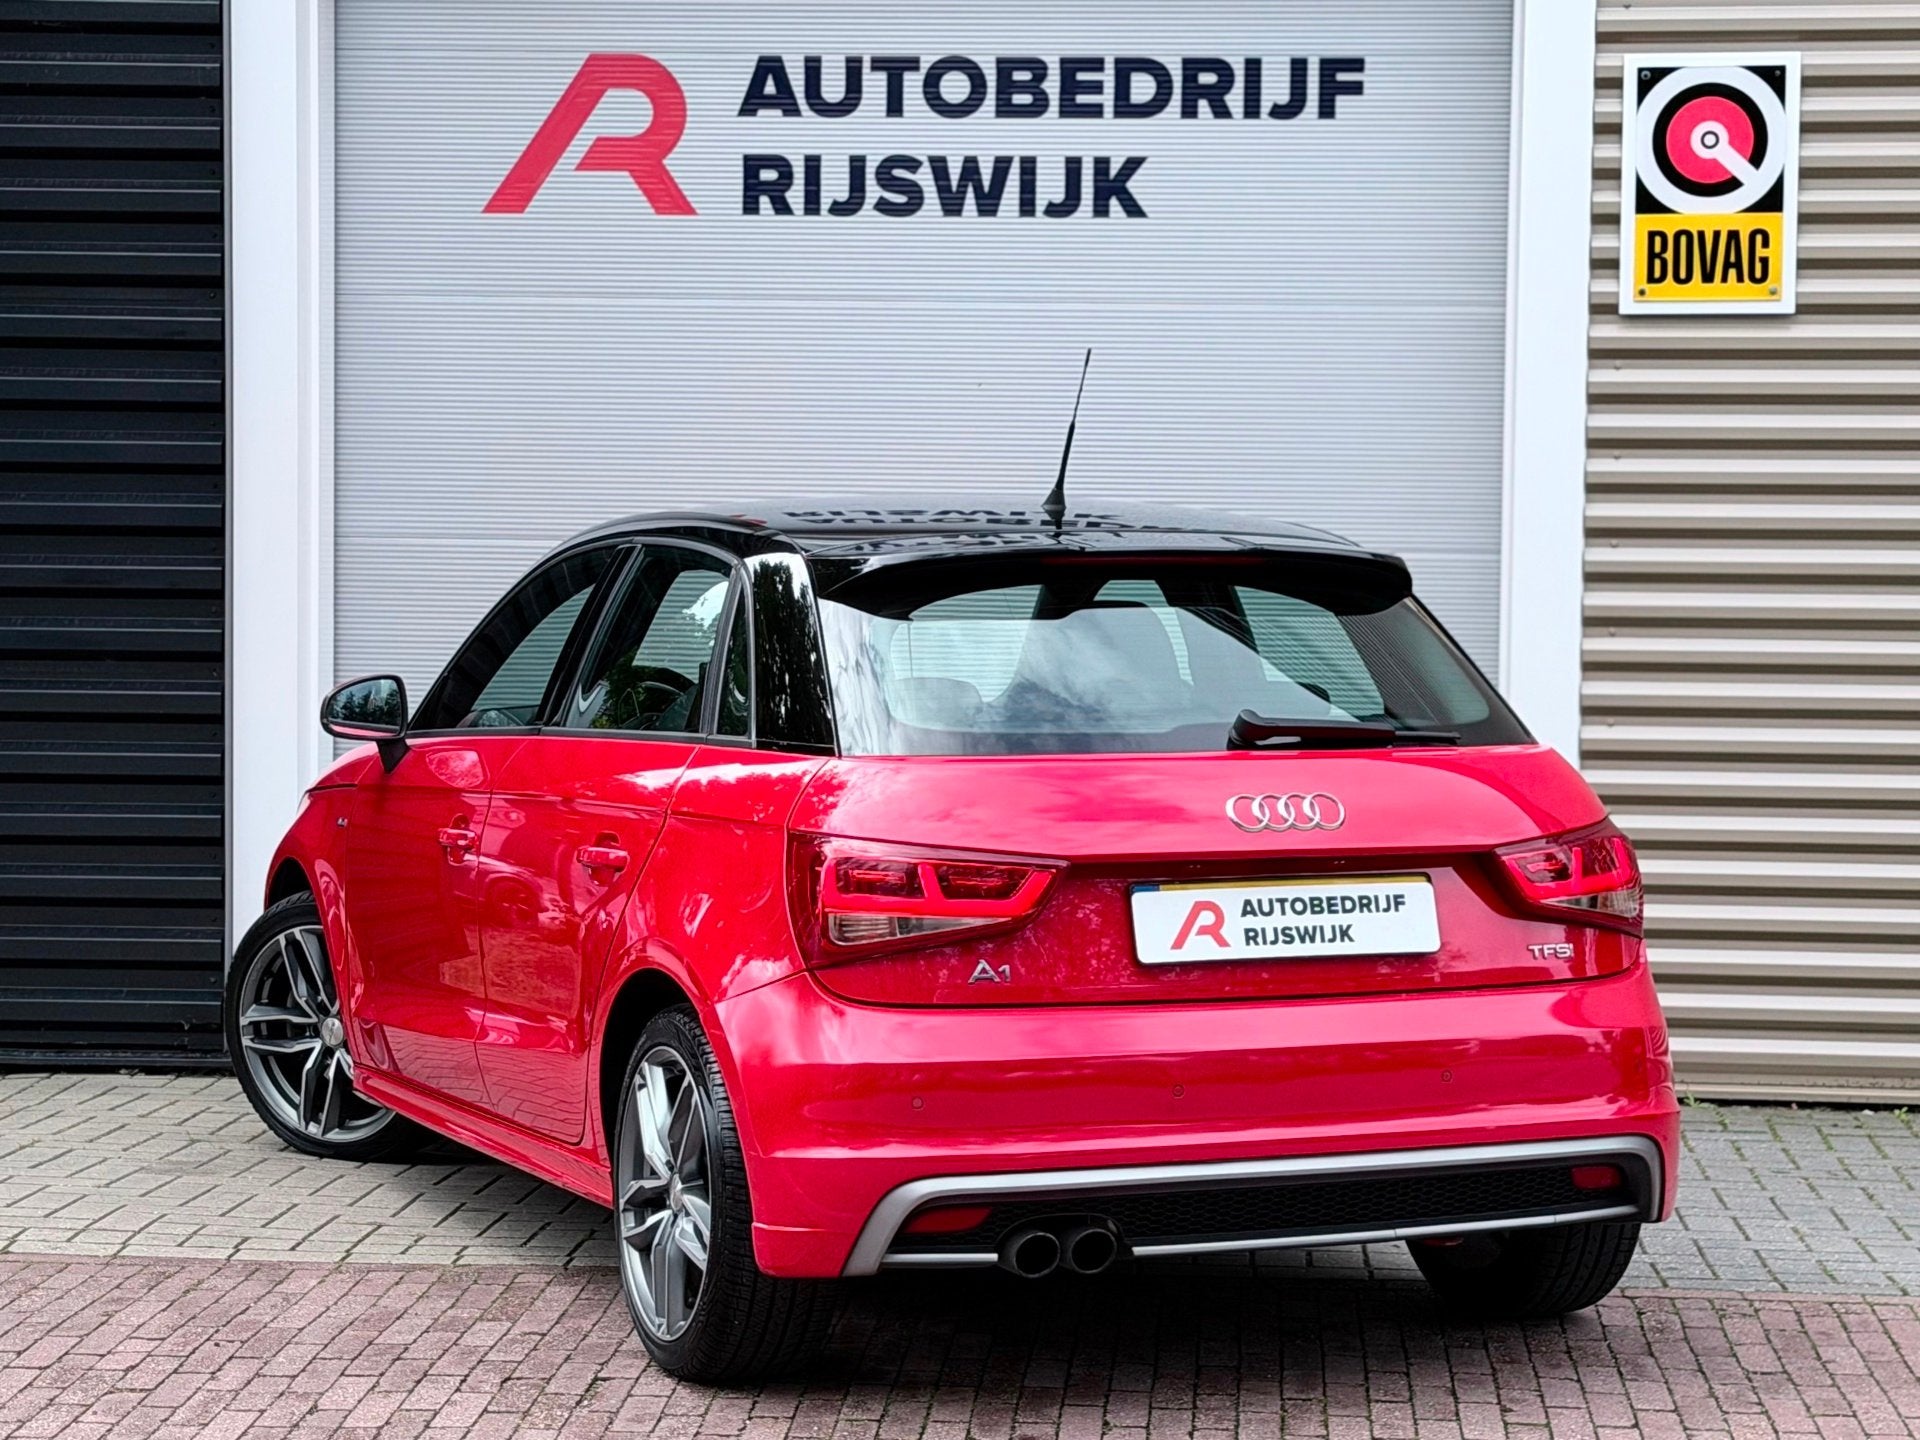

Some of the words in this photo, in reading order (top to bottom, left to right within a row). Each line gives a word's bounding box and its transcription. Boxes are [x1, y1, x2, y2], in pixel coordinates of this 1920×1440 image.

[738, 55, 1365, 120] AUTOBEDRIJF
[743, 154, 1147, 219] RIJSWIJK
[1646, 228, 1771, 285] BOVAG
[1240, 894, 1406, 918] AUTOBEDRIJF
[1243, 924, 1355, 947] RIJSWIJK
[1527, 943, 1575, 959] TFSI
[967, 959, 1011, 983] A1
